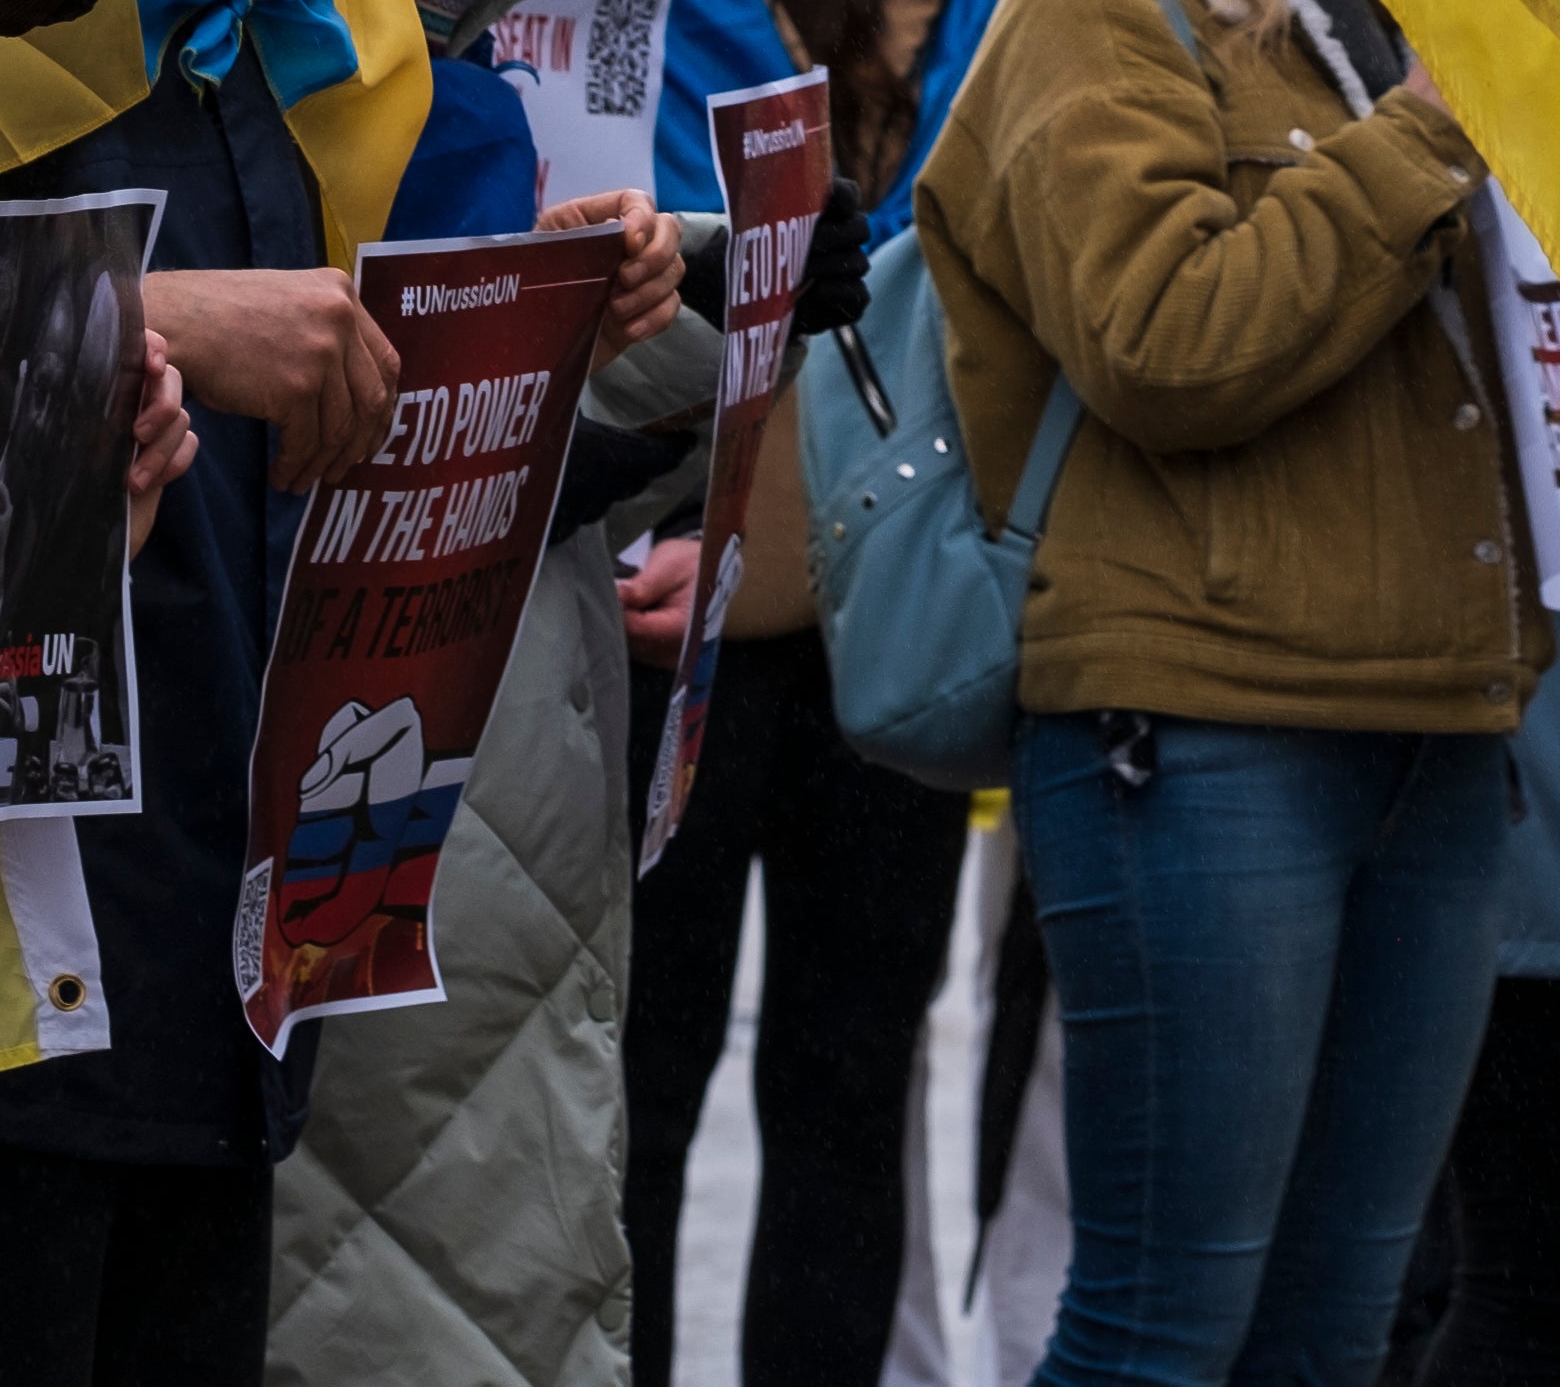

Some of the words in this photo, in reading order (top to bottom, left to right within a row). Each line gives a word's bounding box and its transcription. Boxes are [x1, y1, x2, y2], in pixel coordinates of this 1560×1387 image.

[400, 273, 521, 317] #UNrussiaUN
[730, 221, 773, 308] VETO
[775, 211, 821, 296] POW
[725, 328, 745, 408] IN
[370, 385, 450, 467] ETO
[444, 370, 551, 461] POWER
[309, 488, 371, 564] IN
[362, 485, 444, 563] THE
[432, 464, 530, 559] HANDS
[281, 587, 340, 664] OF
[326, 586, 368, 660] A
[366, 557, 523, 659] TERRORIST
